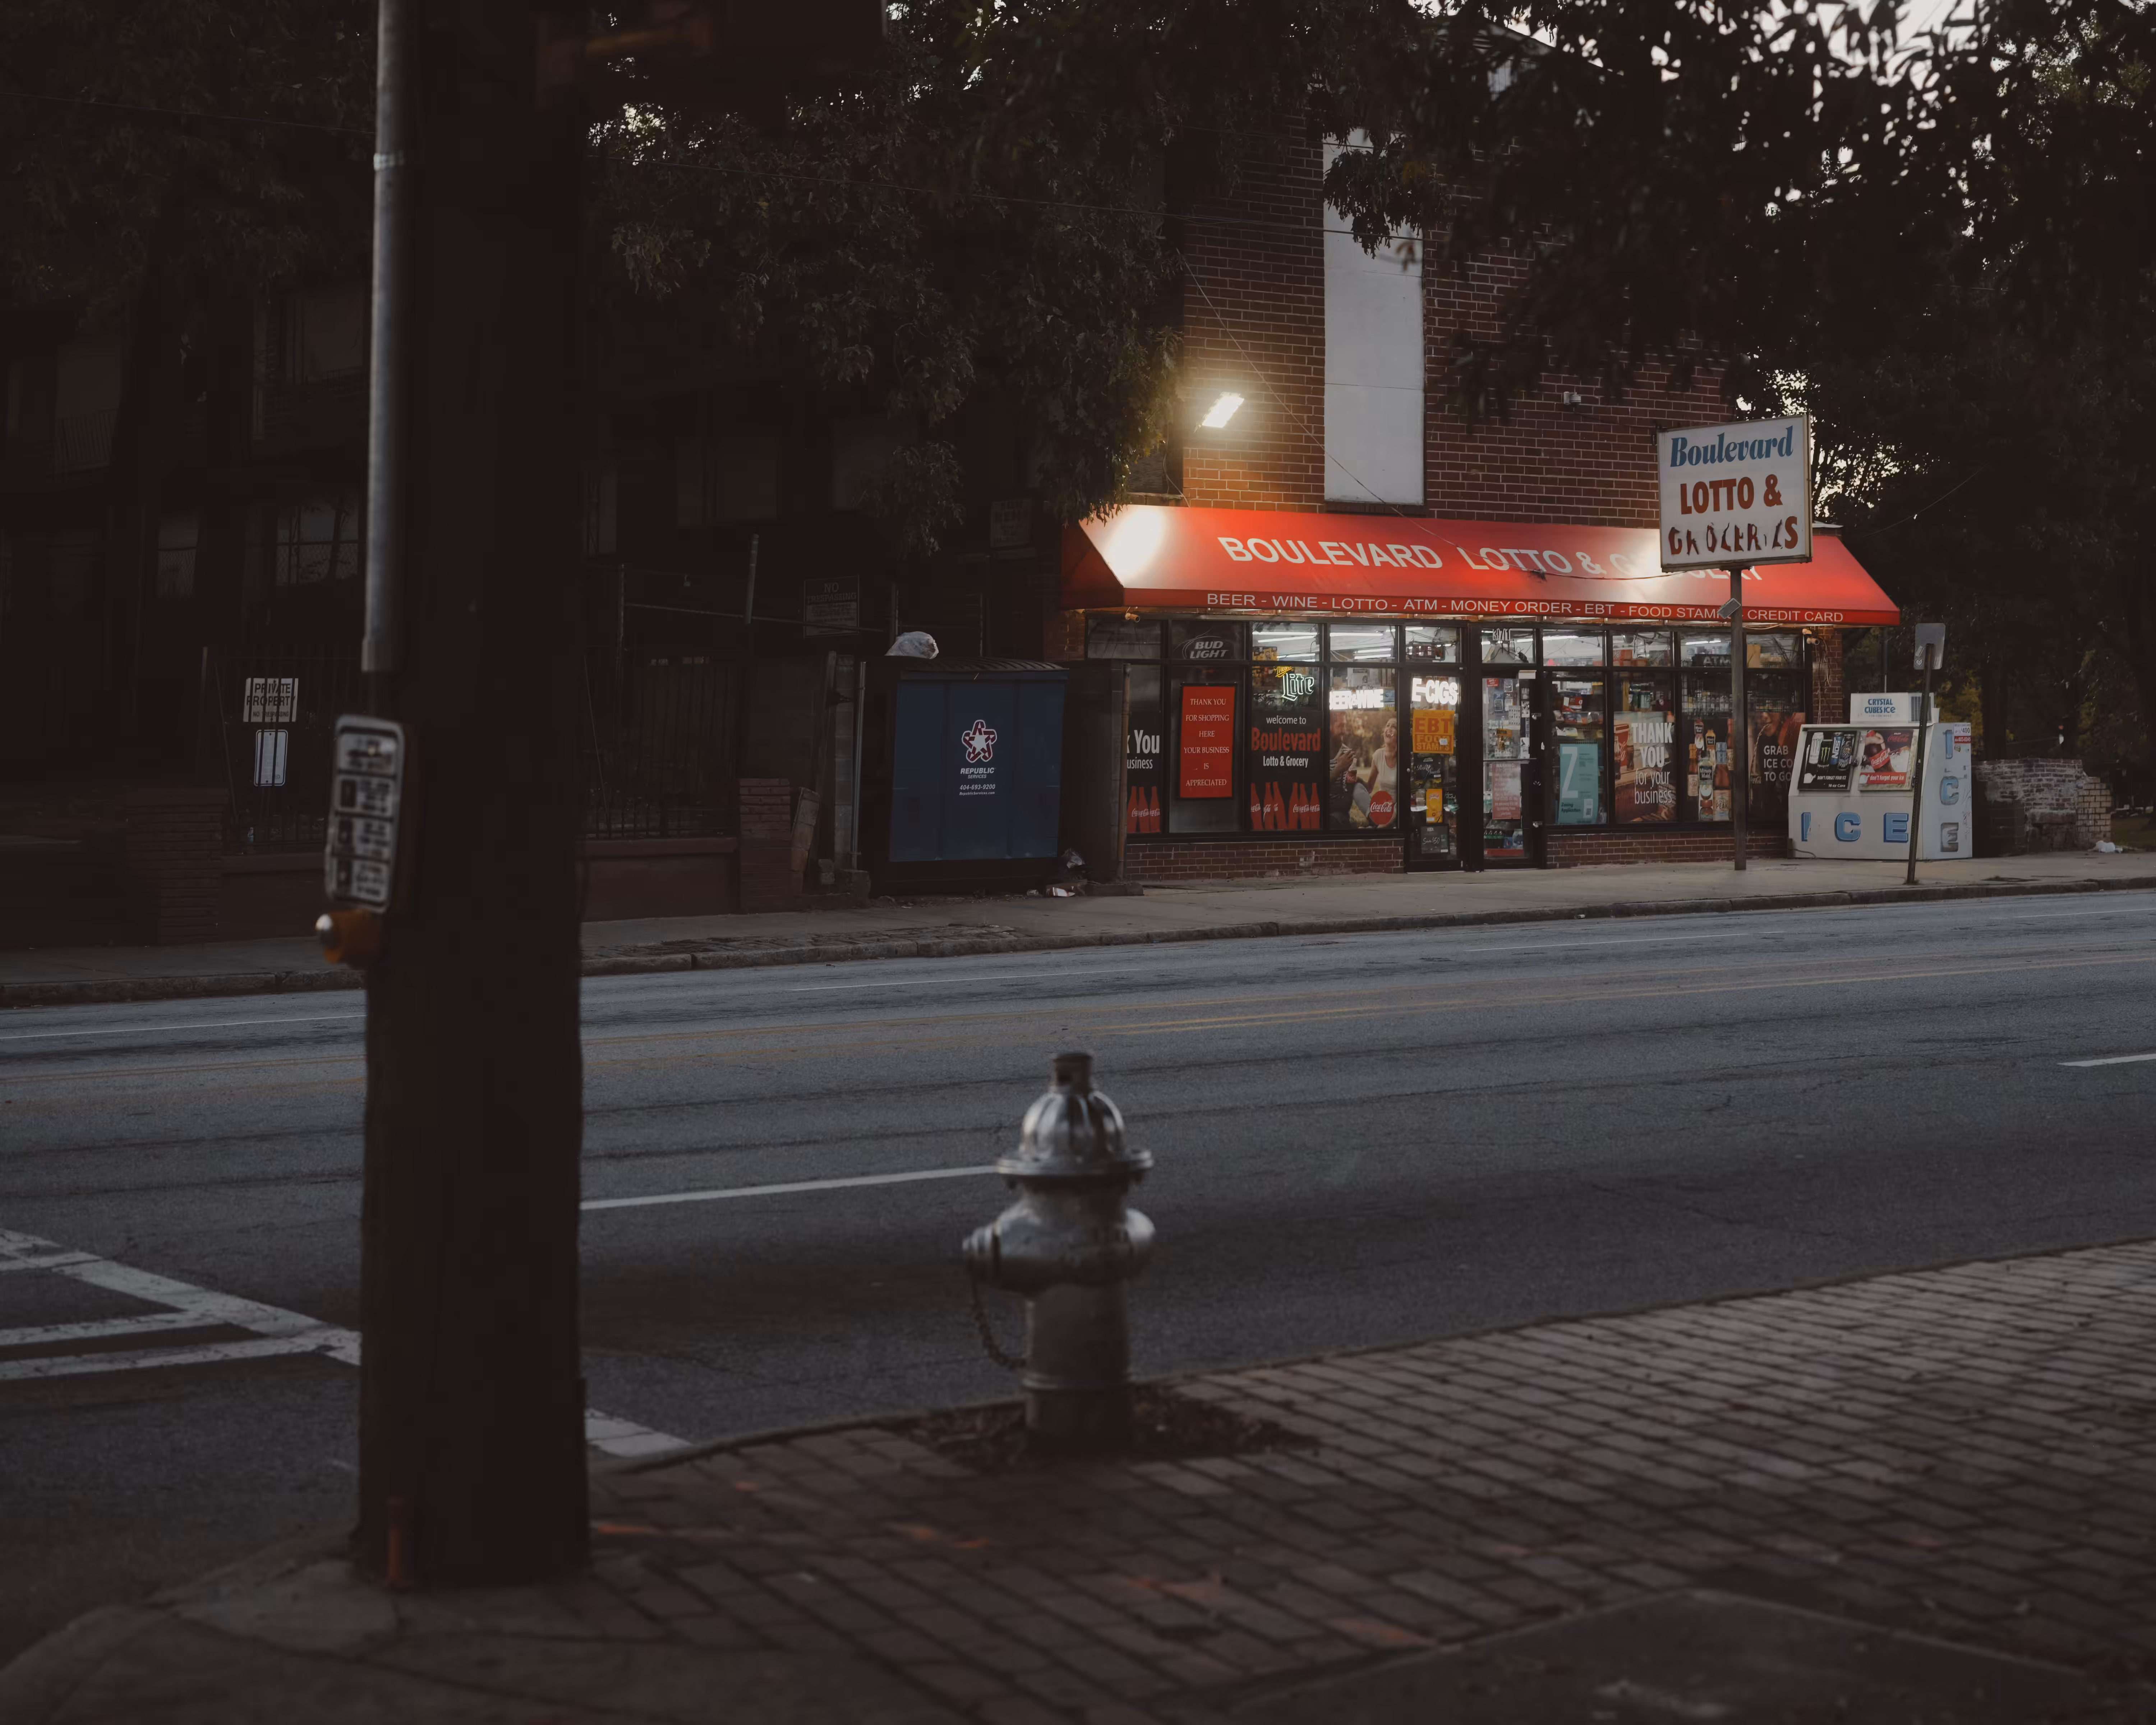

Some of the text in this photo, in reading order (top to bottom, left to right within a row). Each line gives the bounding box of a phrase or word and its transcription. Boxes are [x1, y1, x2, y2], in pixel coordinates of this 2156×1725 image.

[1670, 426, 1793, 467] Boulevard
[1680, 474, 1783, 515] LOTTO &
[1668, 516, 1798, 555] GROCERS
[1217, 537, 1442, 569] BOULEVARD
[1456, 547, 1572, 573] LOTTO
[1576, 551, 1607, 575] &
[824, 583, 839, 593] NO
[1207, 593, 1256, 606] BEER
[1272, 596, 1317, 608] WINE
[1332, 597, 1388, 610] LOTTO
[1404, 599, 1438, 610] ATM
[1451, 600, 1511, 612] MONEY
[1515, 601, 1572, 613] ORDER
[1585, 604, 1614, 614] EBT
[1629, 606, 1672, 617] FOOD
[1677, 607, 1731, 619] STAM
[1748, 610, 1800, 621] CREDIT
[1804, 611, 1843, 622] CARD
[1190, 650, 1228, 659] LIGHT
[1281, 673, 1314, 701] Lite
[1412, 678, 1459, 705] E-CIGS
[1266, 715, 1298, 724] welcome
[1415, 718, 1451, 733] EBT
[1134, 730, 1160, 754] You
[1251, 727, 1321, 751] Boulevard
[1632, 722, 1673, 743] THANK
[1640, 746, 1665, 768] YOU
[1764, 745, 1788, 755] GRAB
[1832, 737, 1841, 759] NOS
[1127, 757, 1153, 769] usiness
[1263, 756, 1308, 768] Lotto & Grocery
[1562, 746, 1578, 798] Z
[1764, 759, 1794, 768] ICE CO
[1635, 768, 1670, 787] for your
[1764, 772, 1776, 781] TO
[1779, 772, 1792, 781] GO
[1635, 787, 1673, 804] business
[1801, 812, 1909, 843] ICE
